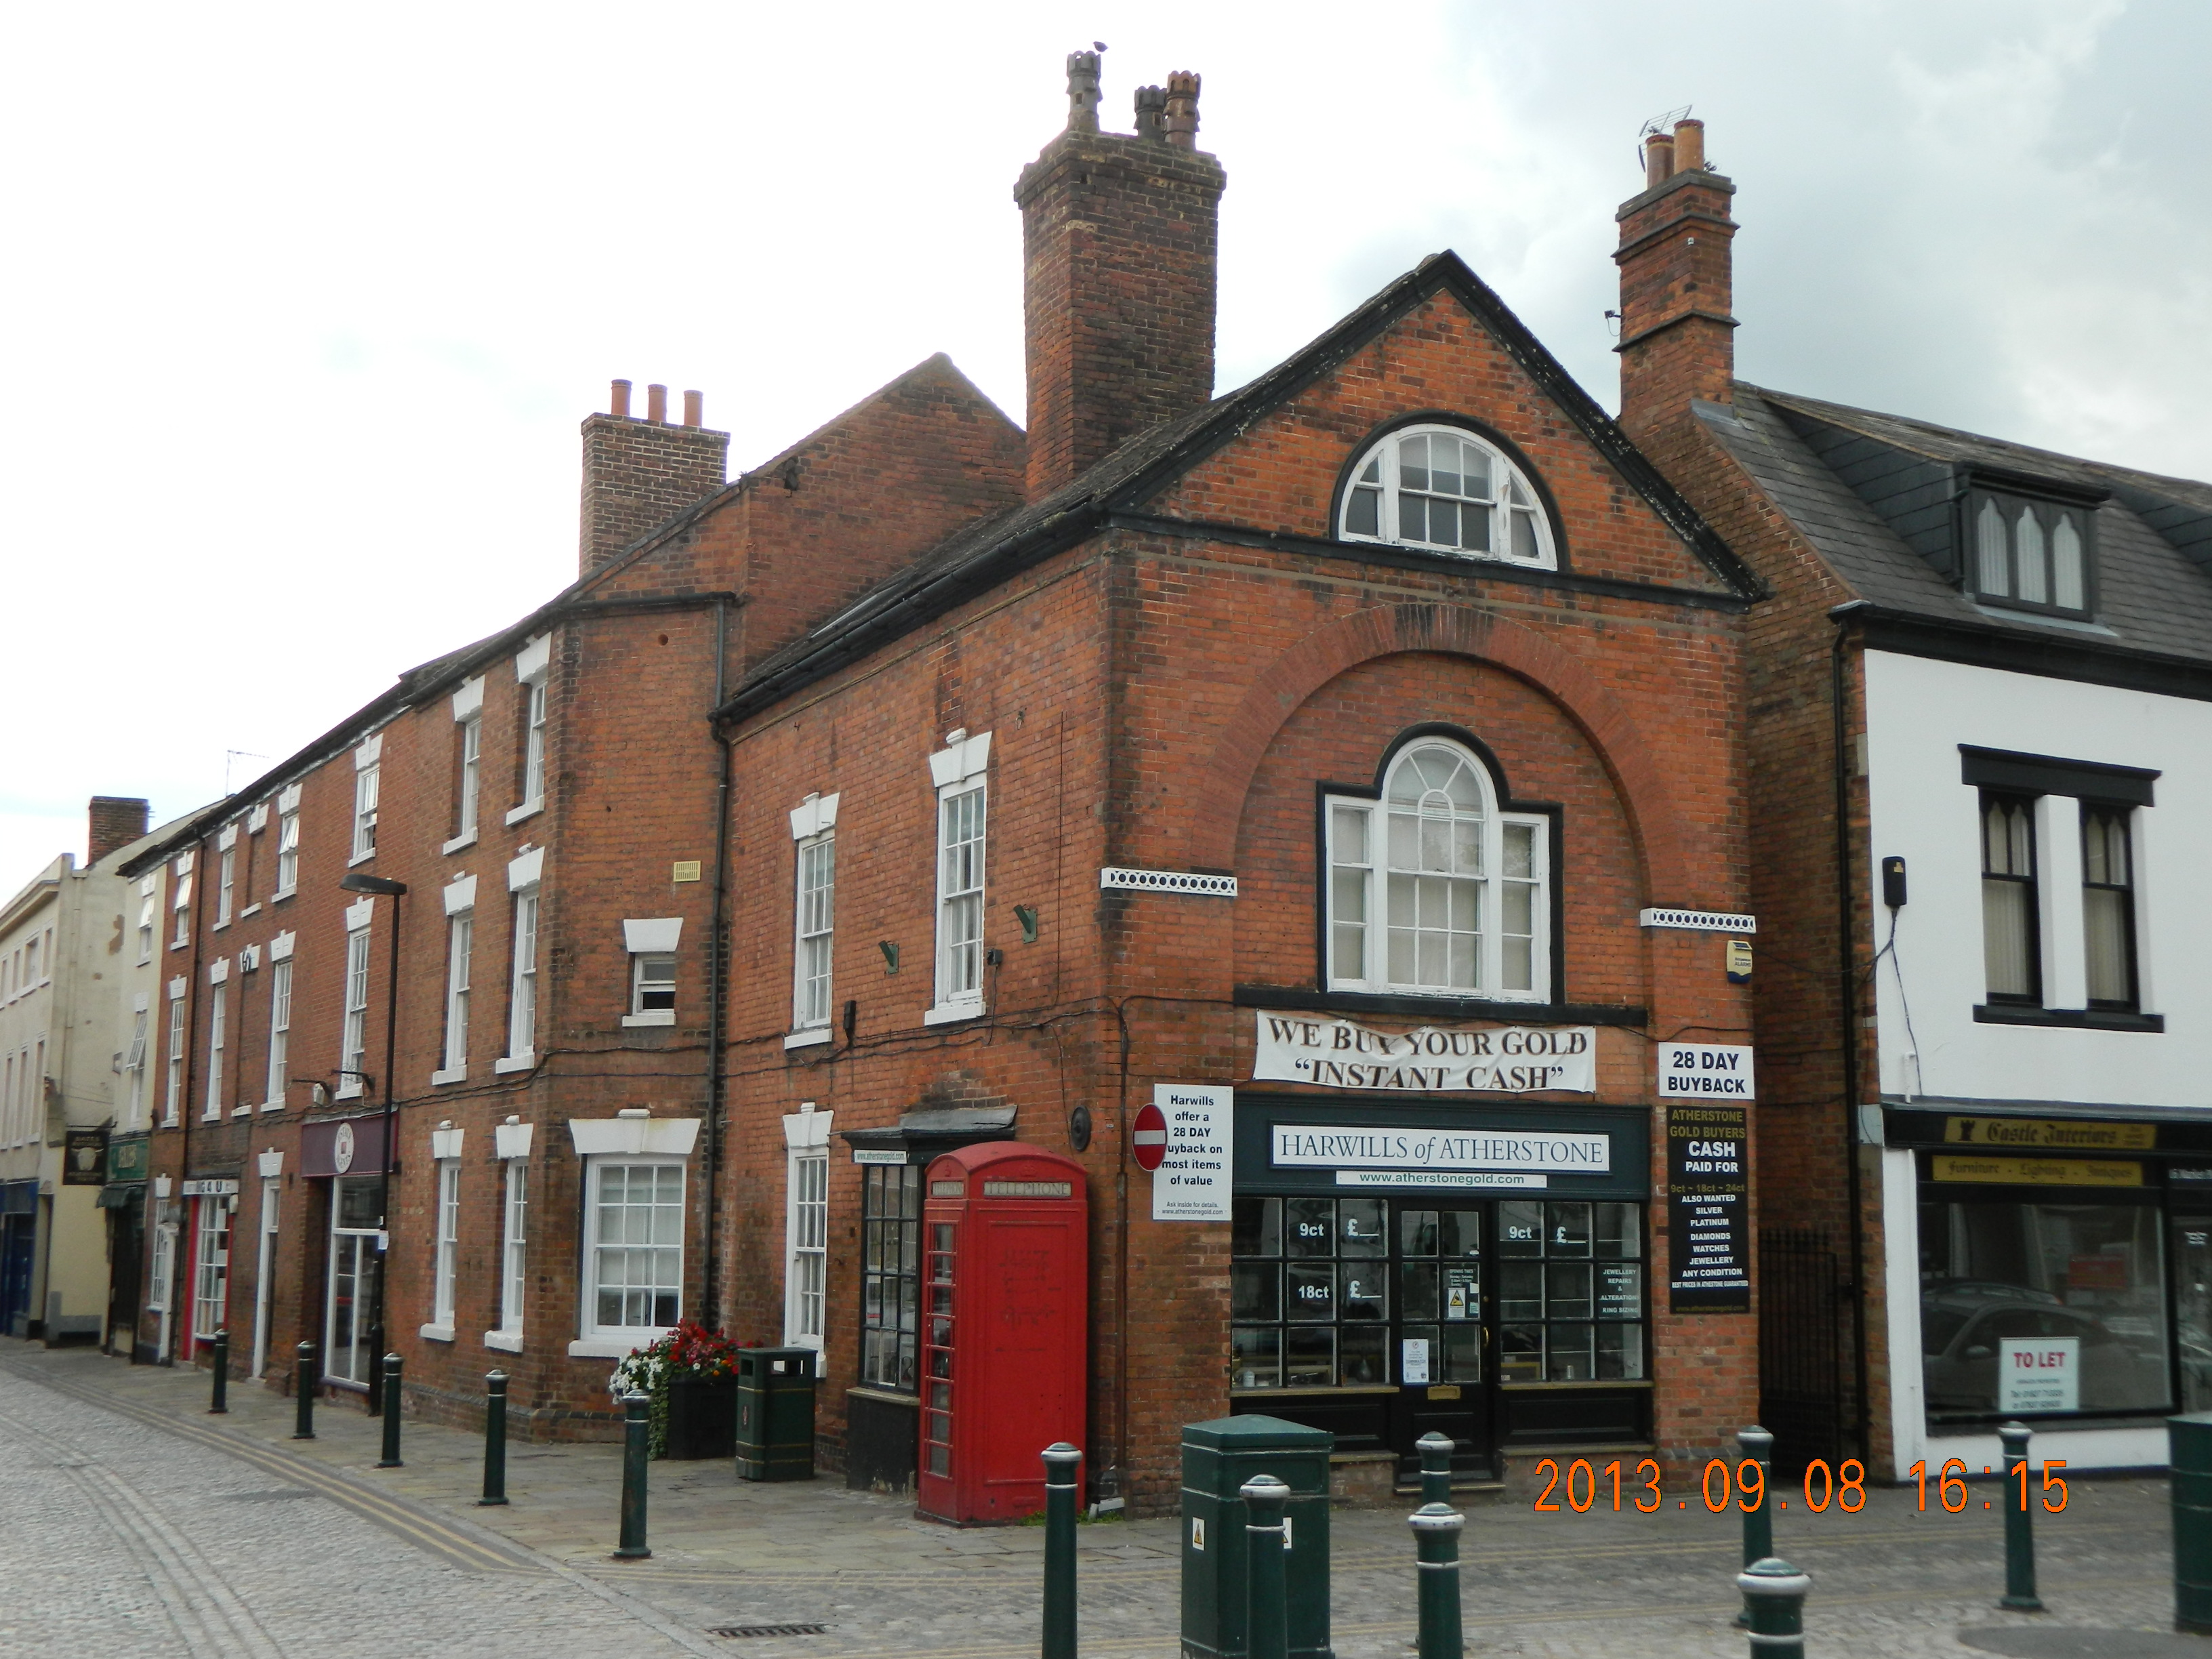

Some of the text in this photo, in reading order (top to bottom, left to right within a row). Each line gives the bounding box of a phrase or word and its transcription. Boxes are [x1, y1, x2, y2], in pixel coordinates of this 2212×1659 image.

[1267, 1017, 1587, 1056] WE BUY YOUR GOLD
[1673, 1051, 1739, 1070] 28 DAY
[1668, 1076, 1746, 1093] BUYBACK
[1170, 1095, 1214, 1106] Harwills
[1175, 1111, 1209, 1122] offer a
[1672, 1109, 1743, 1122] ATHERSTONE
[1174, 1128, 1211, 1138] 28 DAY
[1670, 1126, 1745, 1139] GOLD BUYERS
[1988, 1122, 2038, 1143] Castle
[1167, 1144, 1206, 1154] uyback
[1281, 1134, 1603, 1164] HARWILLS of ATHERSTONE
[1688, 1141, 1736, 1158] CASH
[1162, 1160, 1221, 1170] most items
[1685, 1161, 1738, 1172] PAID FOR
[1170, 1175, 1212, 1185] of value
[1359, 1172, 1524, 1185] www.atherstonegold.com
[988, 1182, 1069, 1195] TELEPHONE
[1671, 1185, 1685, 1193] 9ct
[1696, 1184, 1716, 1192] 18ct
[1725, 1184, 1744, 1192] 24ct
[1682, 1195, 1702, 1203] ALSO
[1696, 1206, 1723, 1214] SILVER
[1300, 1223, 1324, 1236] 9ct
[1509, 1226, 1532, 1239] 9ct
[1691, 1233, 1731, 1241] DIAMONDS
[1689, 1256, 1734, 1265] JEWELLERY
[1700, 1268, 1742, 1277] CONDITION
[1298, 1285, 1329, 1298] 18ct
[2013, 1351, 2066, 1368] TO LET
